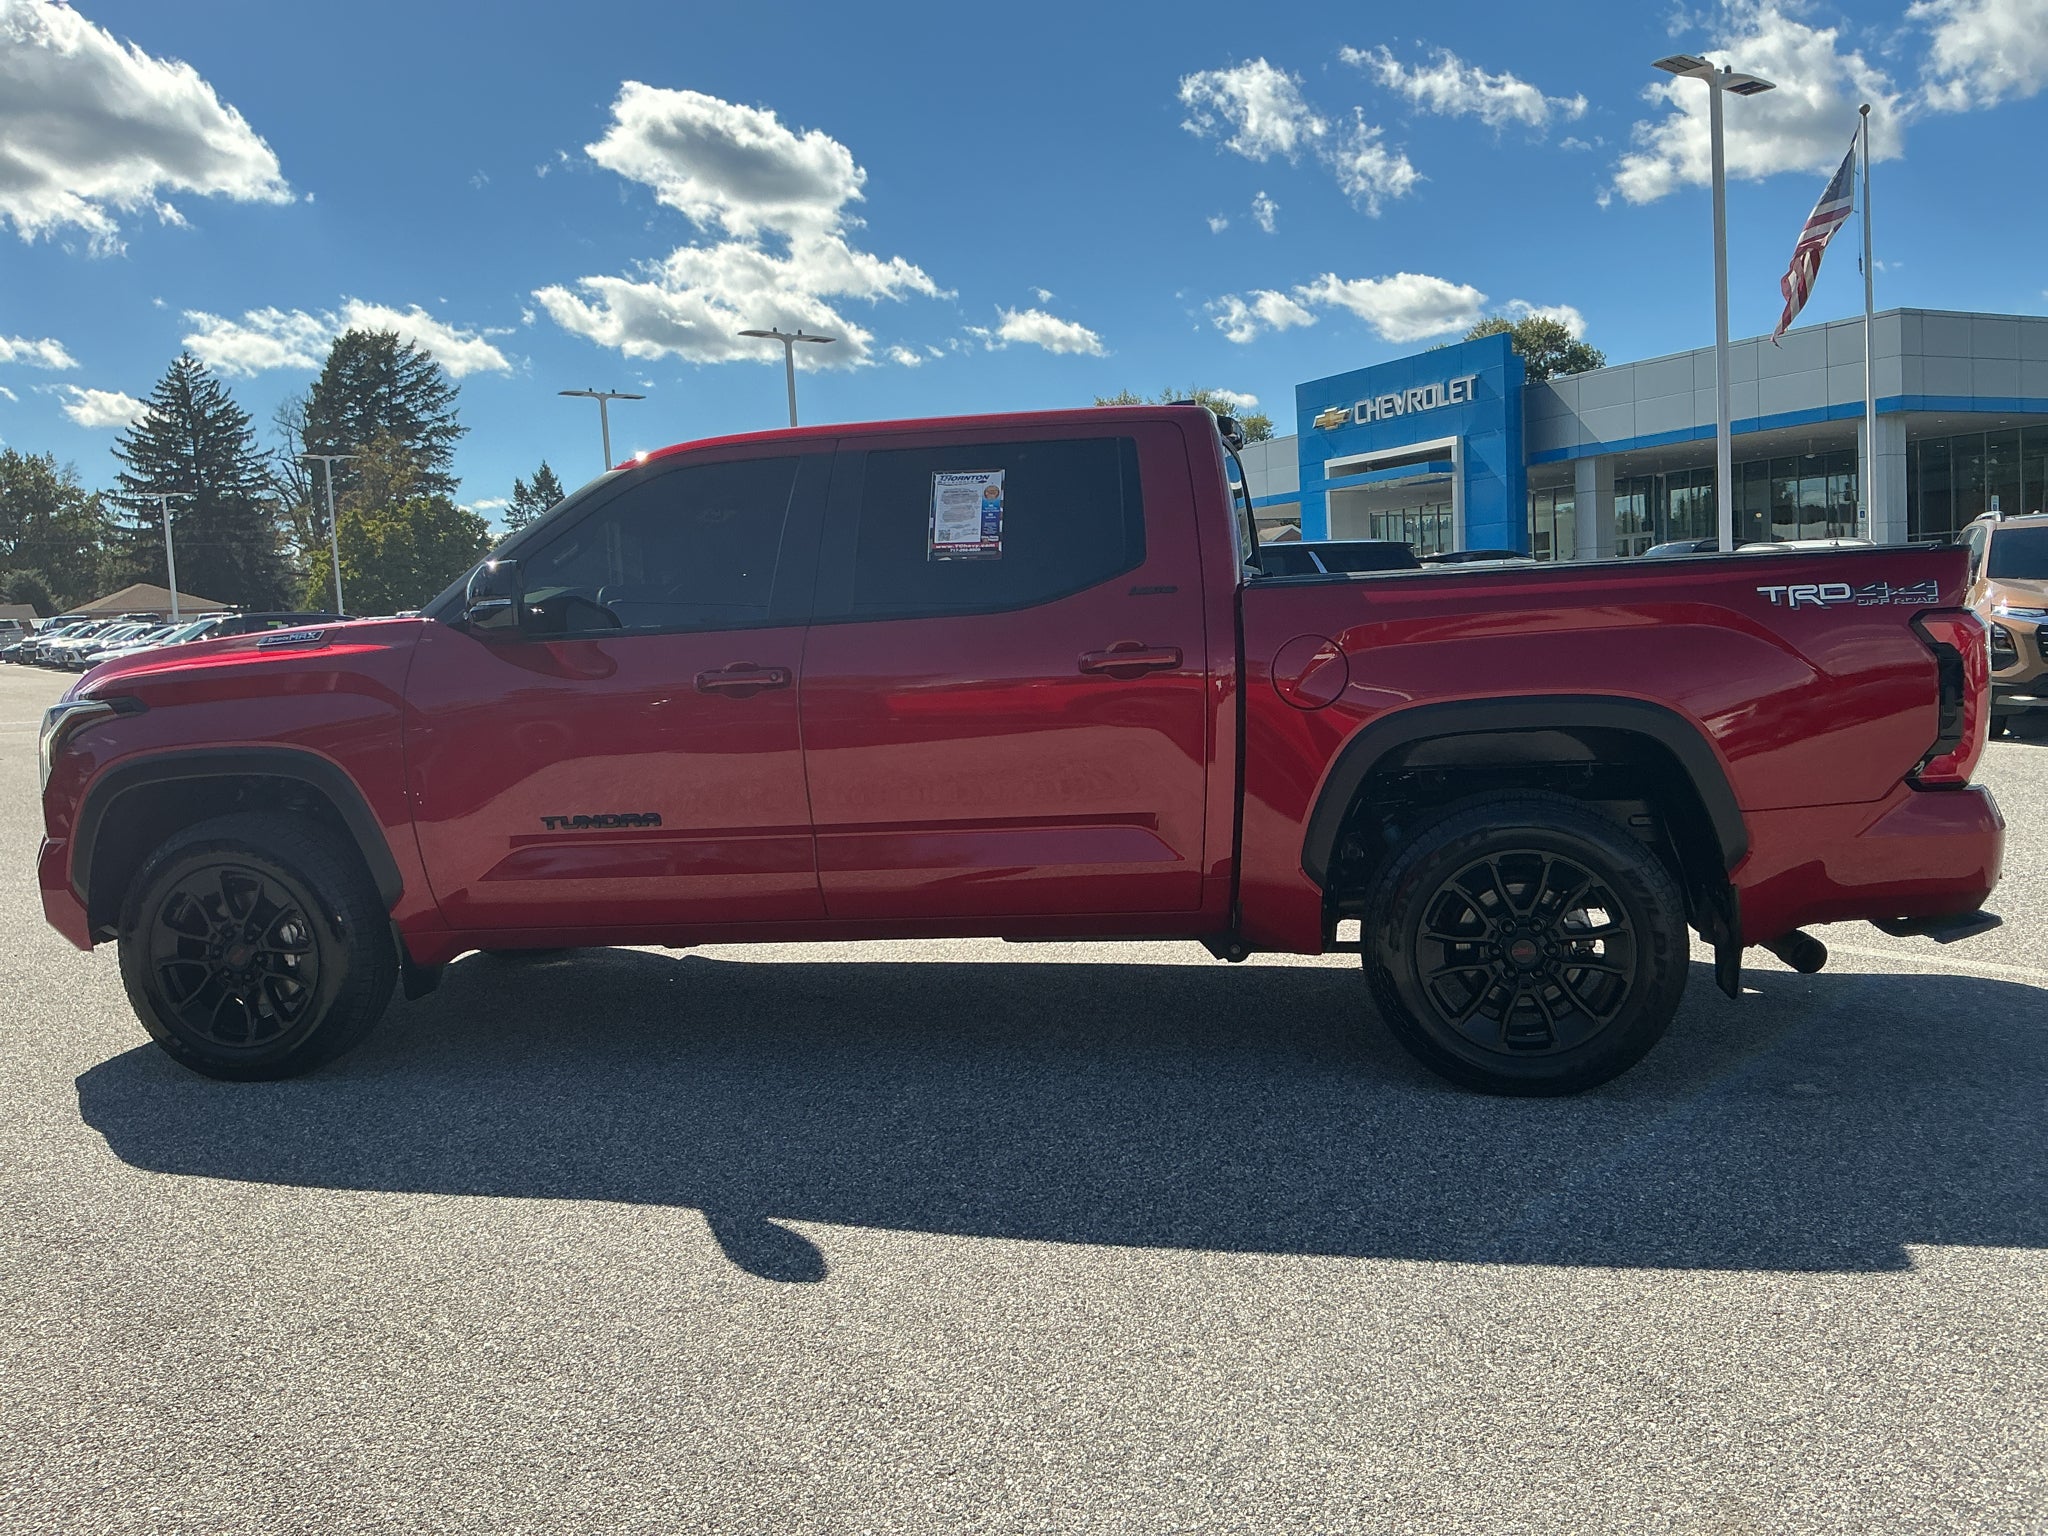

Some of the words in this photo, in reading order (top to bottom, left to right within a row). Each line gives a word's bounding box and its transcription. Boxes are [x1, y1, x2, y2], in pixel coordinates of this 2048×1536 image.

[1355, 374, 1477, 425] CHEVROLET
[1757, 583, 1850, 607] TRD
[1893, 597, 1940, 605] ROAD
[540, 813, 662, 830] TUNDRA
